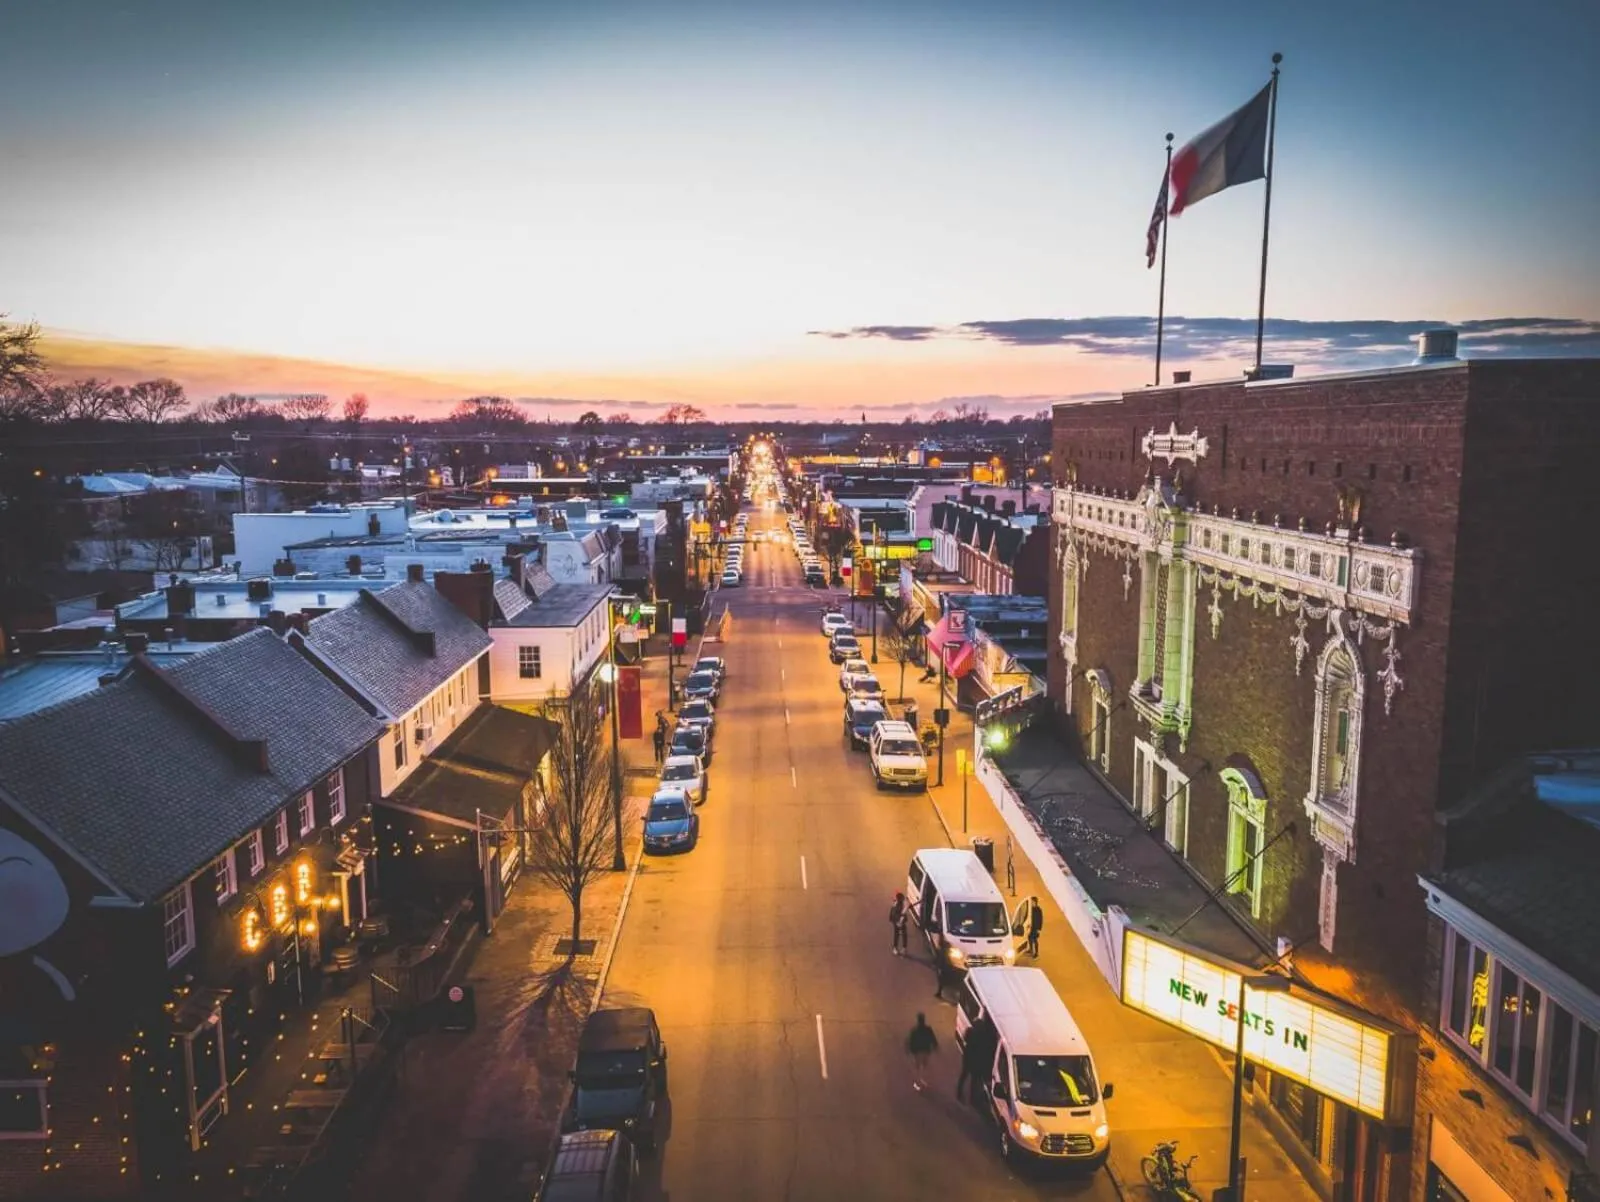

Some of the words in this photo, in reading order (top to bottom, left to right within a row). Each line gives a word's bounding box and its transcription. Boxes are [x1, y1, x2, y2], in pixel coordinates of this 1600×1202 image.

[1169, 978, 1208, 1007] NEW
[1217, 1000, 1275, 1036] SEATS
[1283, 1027, 1308, 1051] IN
